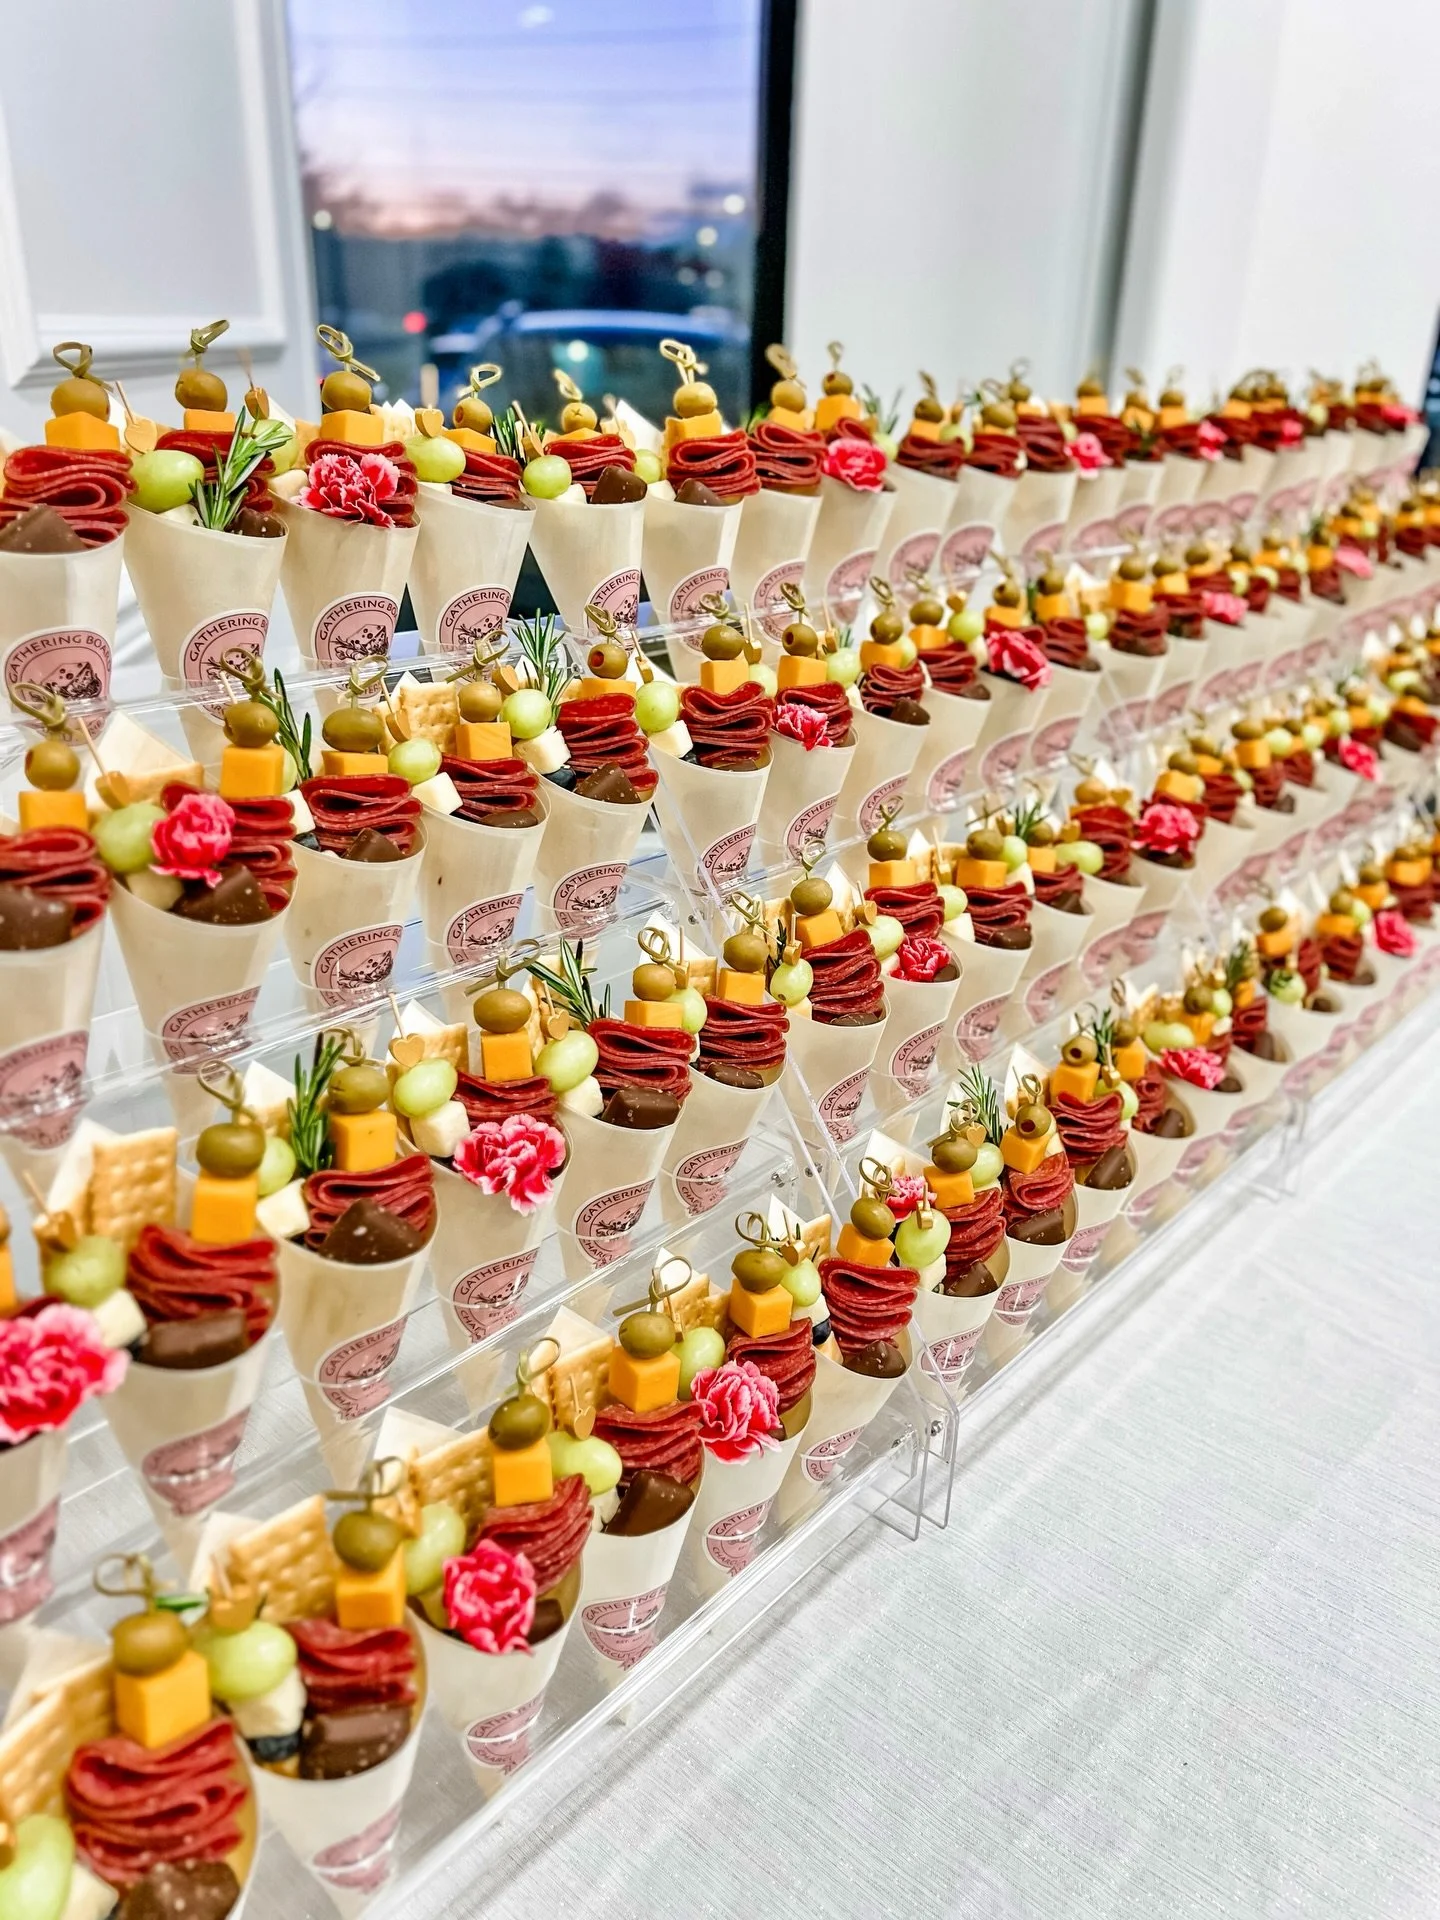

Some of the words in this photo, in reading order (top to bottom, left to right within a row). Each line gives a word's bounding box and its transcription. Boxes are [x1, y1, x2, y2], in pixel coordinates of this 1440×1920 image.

[319, 600, 384, 641] GATHERING
[446, 592, 505, 628] GATHERING
[8, 635, 82, 684] GATHERING
[189, 617, 259, 662] GATHERING
[560, 866, 621, 899] GATHERING
[452, 898, 516, 939] GATHERING
[320, 929, 390, 974] GATHERING
[170, 991, 251, 1033] GATHERING
[582, 1185, 649, 1223] GATHERING
[460, 1255, 532, 1296] GATHERING
